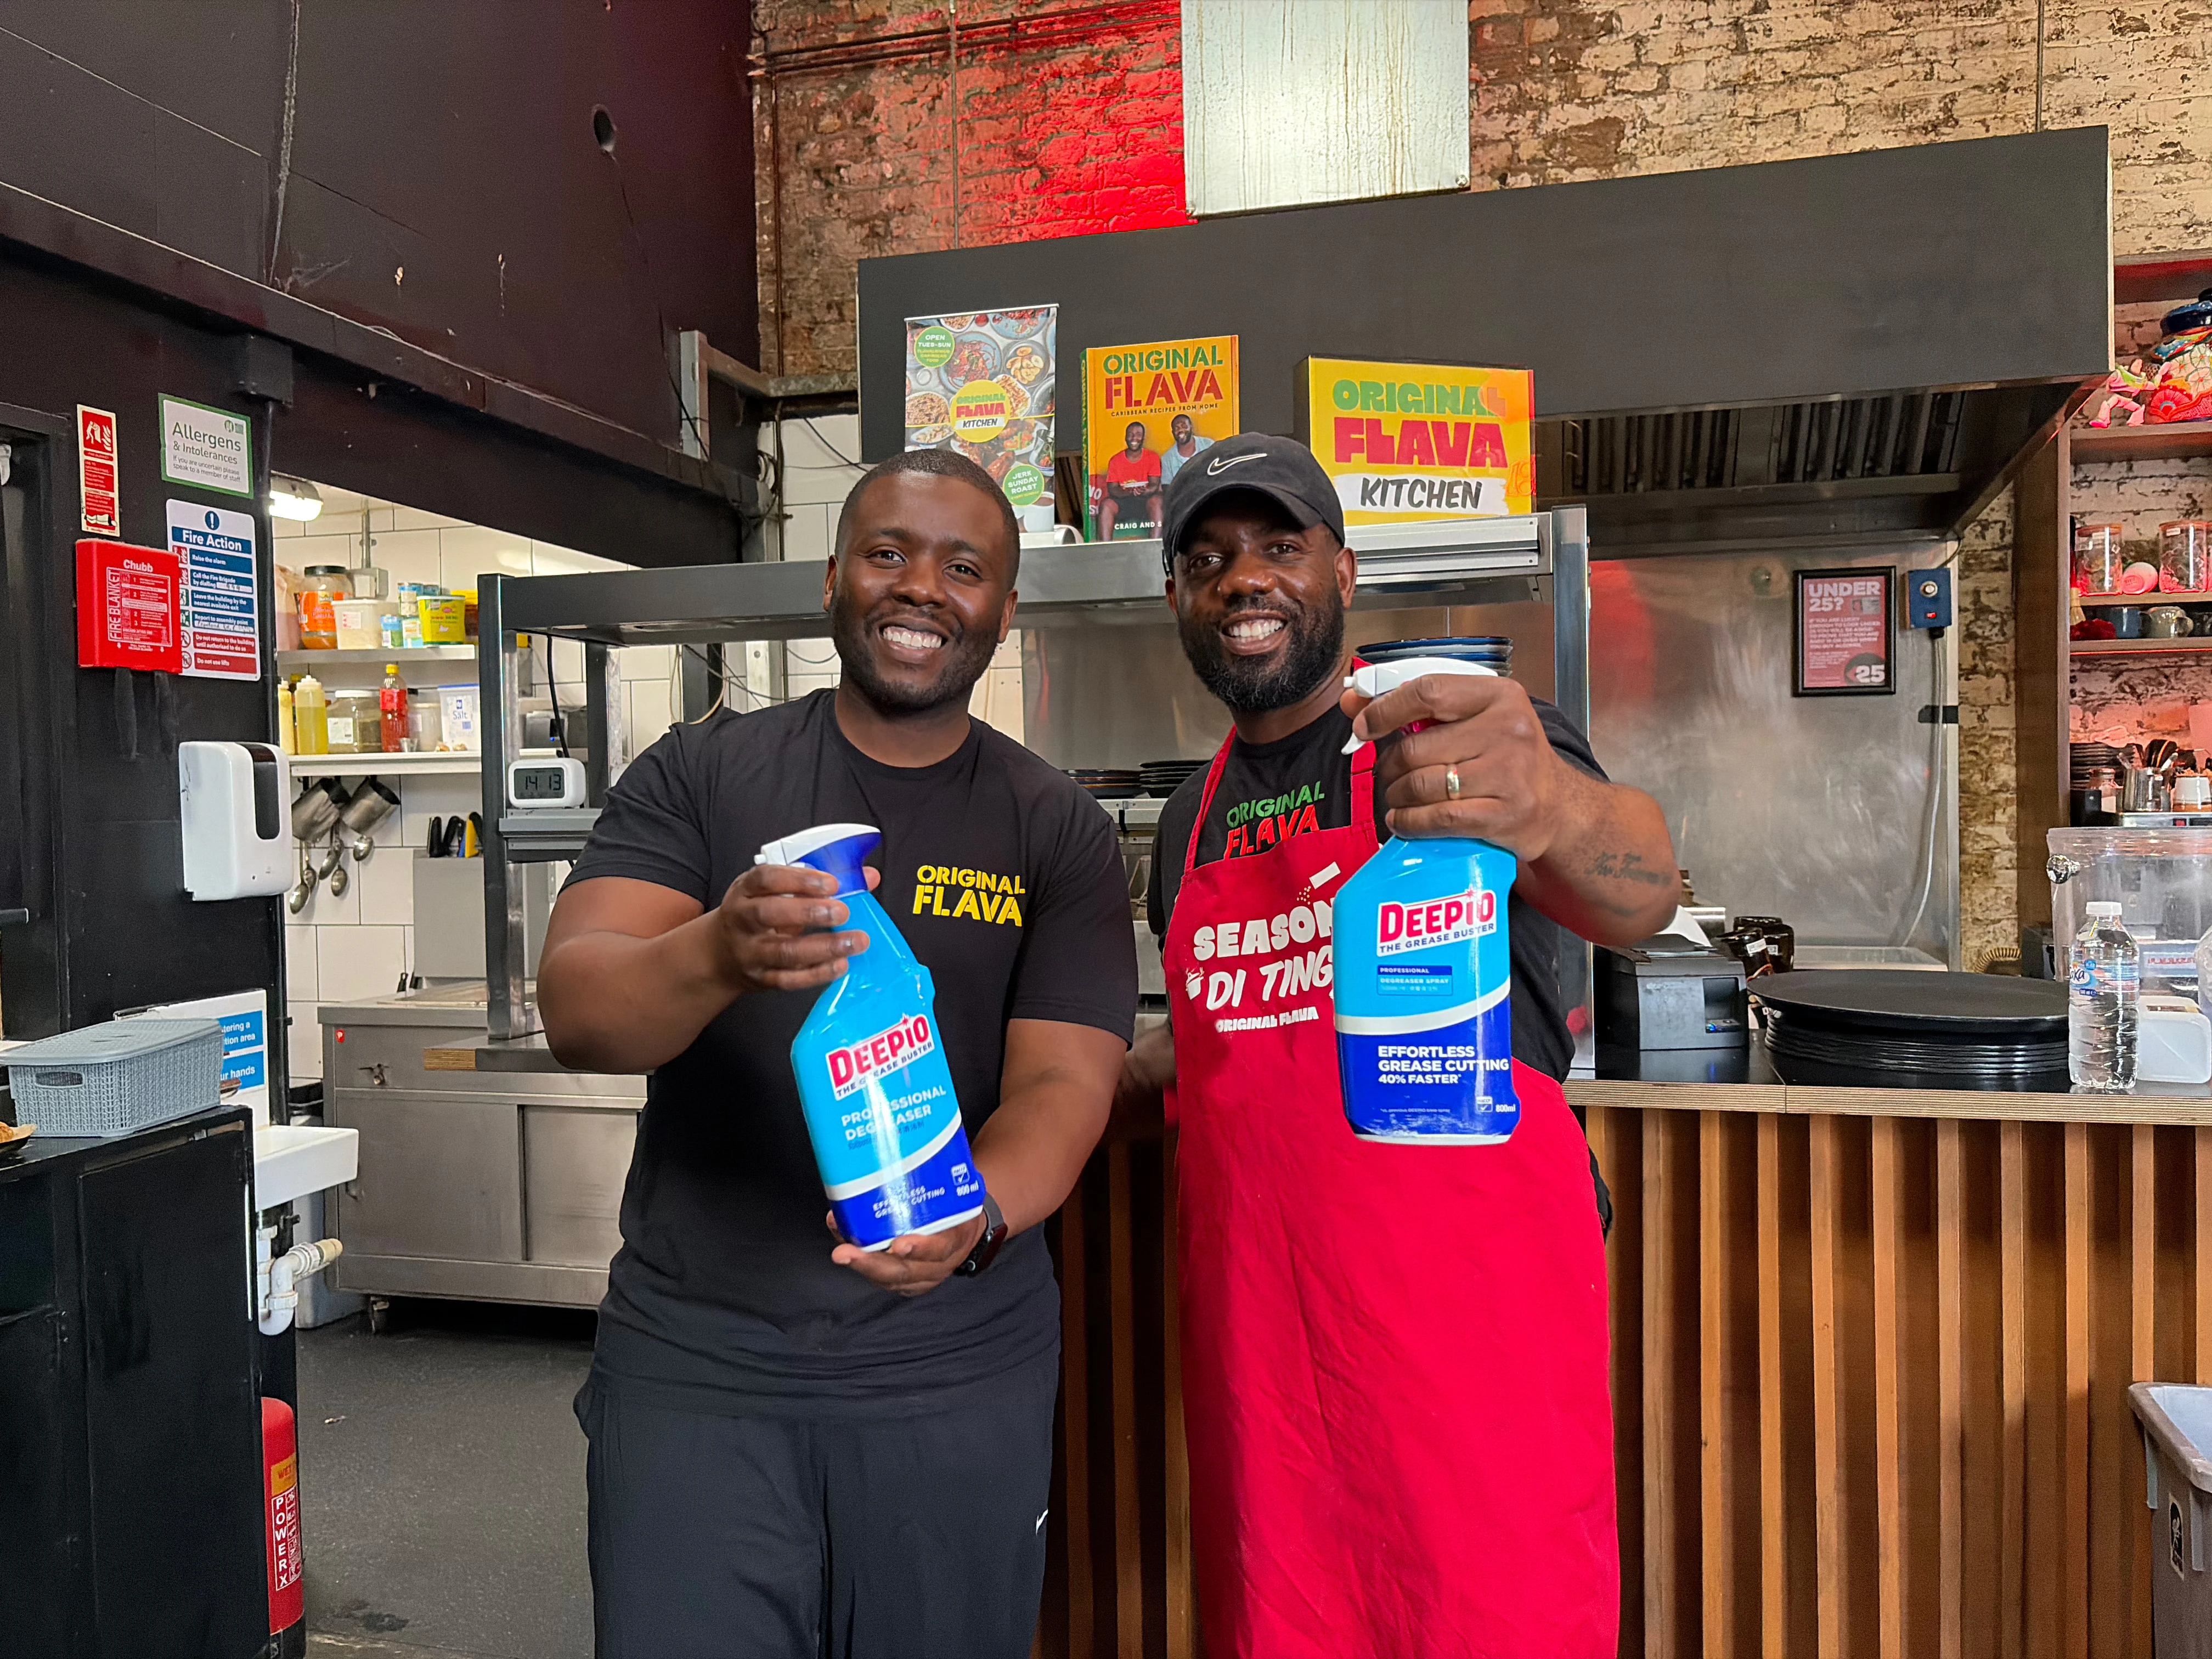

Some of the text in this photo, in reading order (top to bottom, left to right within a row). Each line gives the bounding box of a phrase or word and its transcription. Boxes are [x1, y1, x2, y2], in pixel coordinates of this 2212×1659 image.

[1103, 345, 1223, 375] ORIGINAL
[1105, 369, 1223, 410] FLAVA
[957, 393, 1005, 404] ORIGINAL
[1333, 379, 1506, 417] ORIGINAL
[956, 402, 1005, 418] FLAVA
[1111, 409, 1147, 417] CARIBBEAN
[963, 418, 997, 428] KITCHEN
[172, 421, 241, 452] Allergens
[1334, 416, 1508, 468] FLAVA
[173, 441, 238, 465] & Intolerances
[173, 463, 188, 471] speak
[201, 470, 222, 478] member
[199, 462, 222, 472] uncertain
[223, 467, 240, 476] please
[1012, 470, 1032, 479] JERK
[1008, 476, 1038, 487] SUNDAY
[1011, 483, 1037, 494] ROAST
[1360, 477, 1482, 509] KITCHEN
[183, 529, 241, 551] Fire Action
[123, 559, 154, 573] Chubb
[200, 580, 216, 589] dialling
[1809, 581, 1881, 597] UNDER
[109, 569, 121, 639] FIRE BLANKET
[215, 595, 233, 604] building
[1809, 597, 1844, 612] 25?
[216, 617, 236, 625] assembly
[237, 638, 254, 646] building
[1855, 664, 1885, 683] 25
[453, 710, 467, 720] Salt
[1226, 781, 1325, 828] ORIGINAL
[1223, 804, 1320, 860] FLAVA
[917, 864, 1026, 895] ORIGINAL
[912, 884, 1023, 927] FLAVA
[1193, 897, 1335, 961] SEASON
[1379, 922, 1494, 953] THE GREASE BUSTER
[1206, 969, 1246, 1011] DI
[1215, 1006, 1319, 1033] ORIGINAL FLAVA
[222, 1023, 244, 1033] tering
[240, 1033, 255, 1042] area
[1378, 1046, 1475, 1058] EFFORTLESS
[230, 1065, 255, 1079] hands
[837, 1041, 932, 1097] THE GEASE BUSTER
[1378, 1058, 1509, 1072] GREASE CUTTING
[1378, 1074, 1406, 1084] 40%
[841, 1085, 947, 1127] PROSSIONAL
[1496, 1103, 1516, 1113] 800ml
[845, 1104, 932, 1141] DEGASER
[911, 1187, 945, 1205] CUTTING
